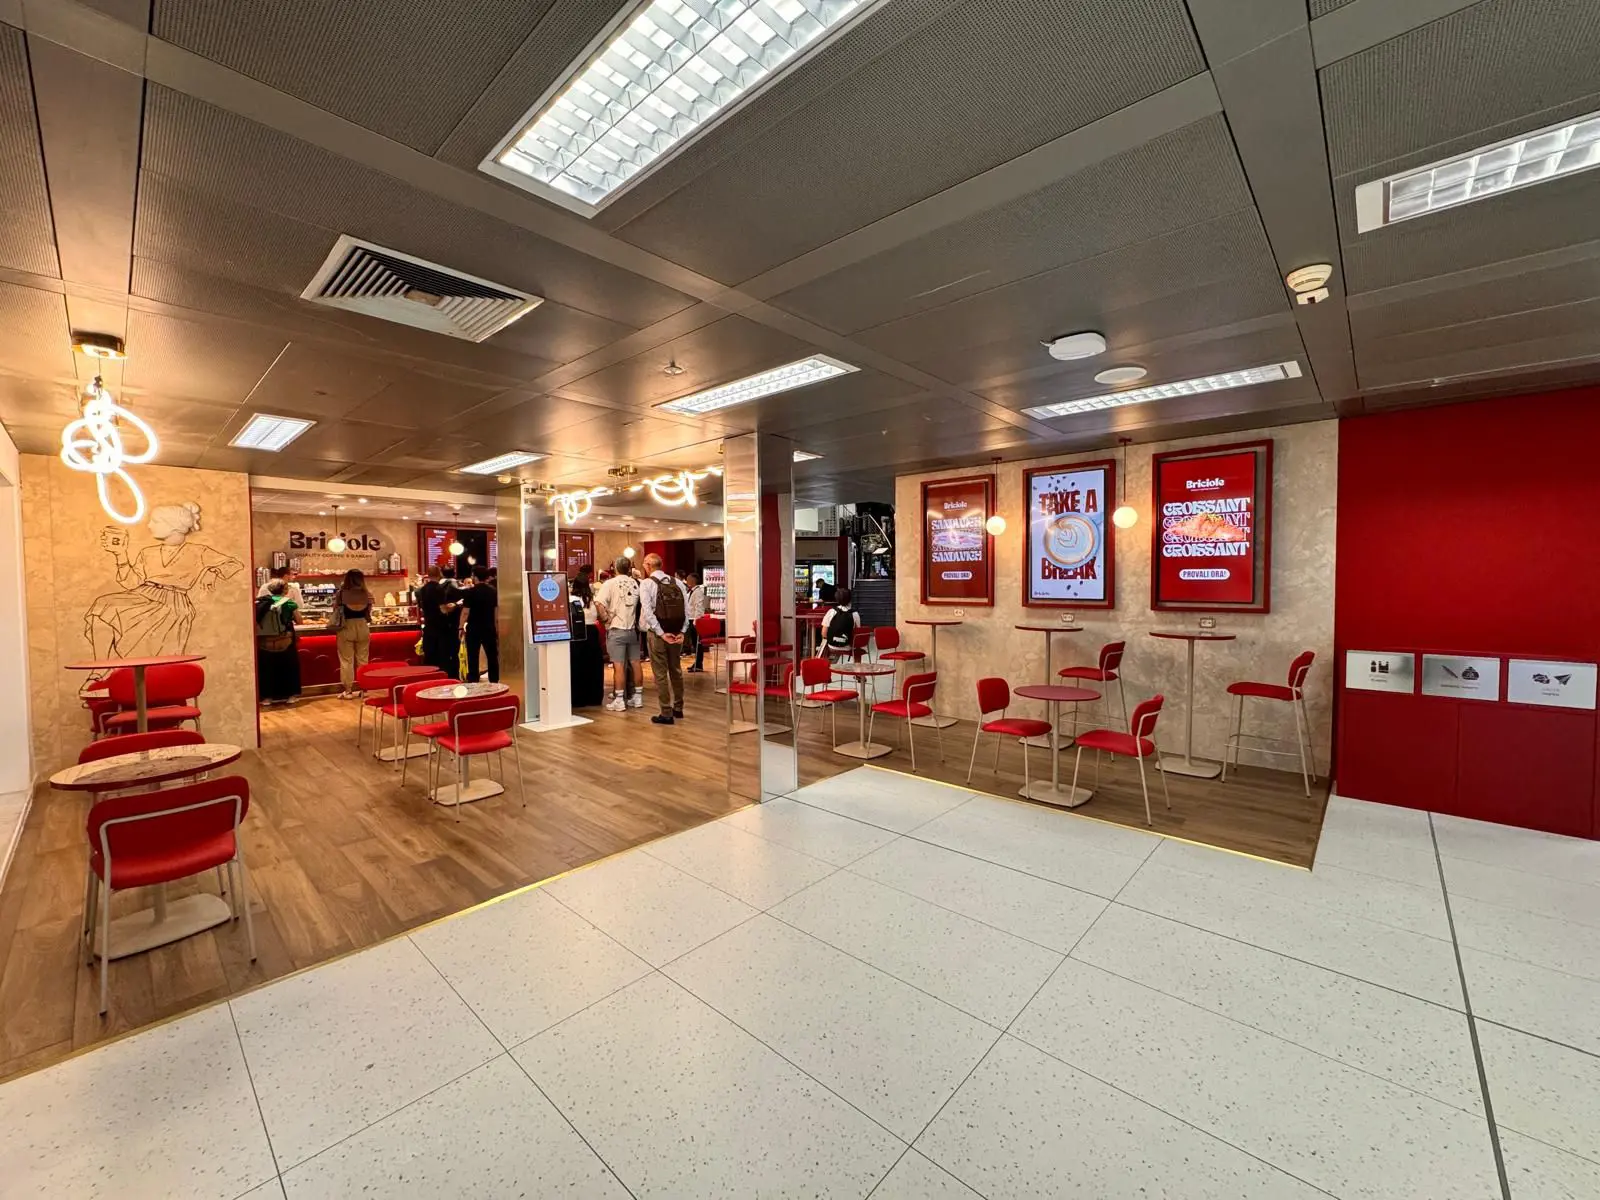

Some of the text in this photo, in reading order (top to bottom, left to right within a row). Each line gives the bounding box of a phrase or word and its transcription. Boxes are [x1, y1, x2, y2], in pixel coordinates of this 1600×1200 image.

[1186, 478, 1225, 489] Briciole
[1039, 489, 1098, 515] TAKE A
[1162, 497, 1251, 516] CROISSANT
[111, 537, 121, 546] B
[289, 531, 381, 551] Briiole
[1162, 542, 1250, 557] CROISSANT
